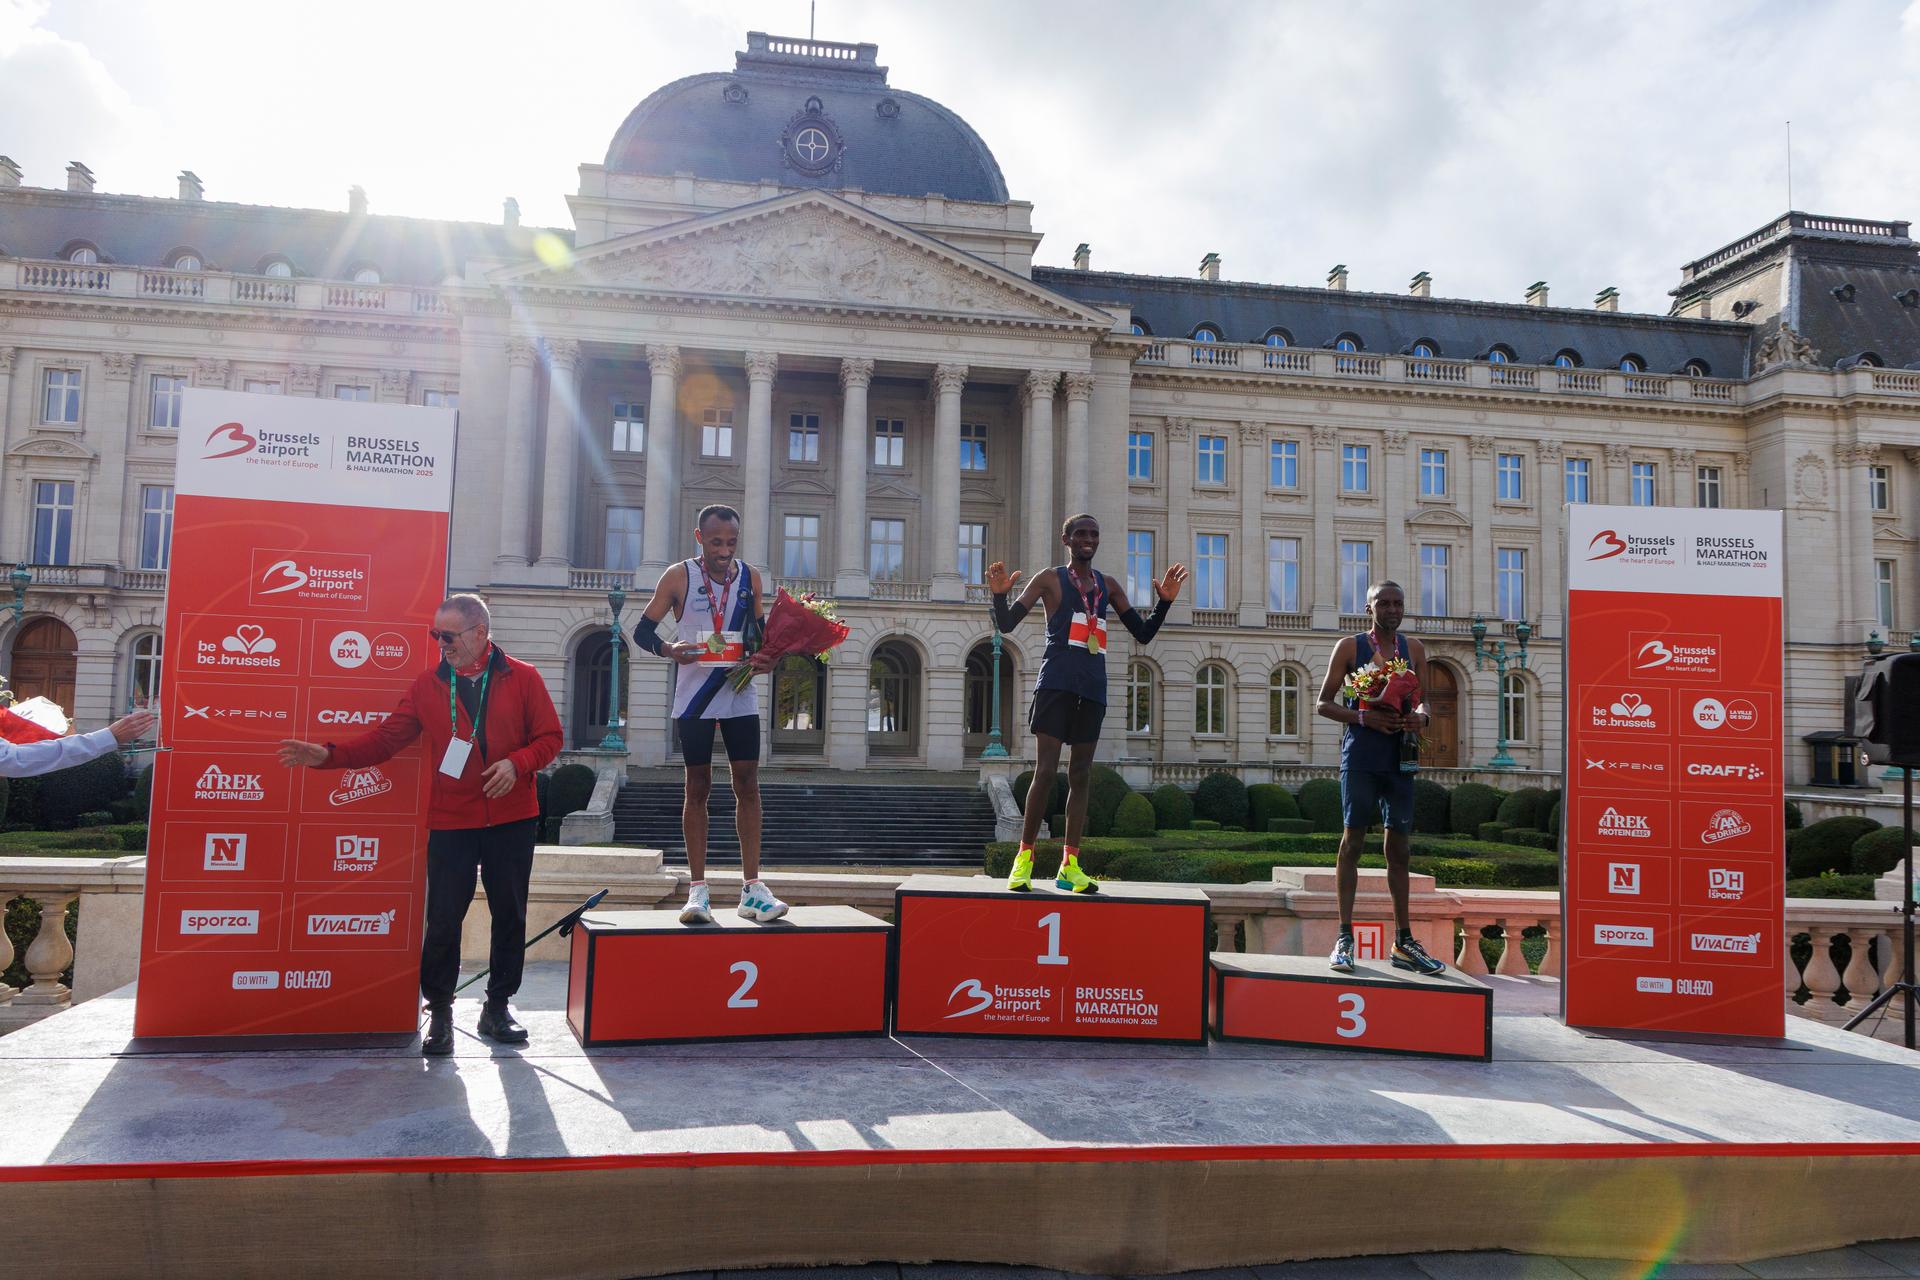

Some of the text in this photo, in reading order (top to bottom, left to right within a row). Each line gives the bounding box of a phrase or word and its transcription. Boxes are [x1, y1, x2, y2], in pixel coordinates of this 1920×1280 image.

[259, 430, 320, 445] brussels
[347, 436, 419, 452] BRUSSELS
[258, 443, 309, 457] airport
[261, 458, 281, 466] heart
[292, 460, 319, 469] Europe
[346, 450, 435, 467] MARATHON
[372, 467, 414, 475] MARATHON
[1628, 535, 1675, 546] brussels
[1696, 537, 1754, 548] BRUSSELS
[1628, 545, 1667, 556] airport
[1696, 549, 1767, 560] MARATHON
[310, 566, 363, 580] brussels
[309, 578, 354, 591] airport
[198, 640, 216, 652] be
[1673, 645, 1716, 656] brussels
[337, 648, 362, 659] BXL
[1673, 654, 1709, 666] airport
[214, 709, 287, 718] XPENG
[318, 710, 392, 724] CRAFT
[1593, 706, 1606, 716] be
[1700, 713, 1719, 722] BXL
[1609, 762, 1664, 771] XPENG
[1687, 764, 1747, 777] CRAFT
[202, 773, 264, 790] TREK
[353, 773, 376, 789] AA
[195, 791, 238, 800] PROTEIN
[242, 792, 262, 800] BARS
[349, 784, 381, 799] DRINK
[1604, 815, 1650, 829] TREK
[1720, 817, 1737, 830] AA
[1598, 828, 1631, 836] PROTEIN
[1717, 826, 1742, 840] DRINK
[211, 838, 240, 861] N
[339, 839, 374, 857] DH
[1614, 867, 1635, 886] N
[1712, 872, 1740, 888] DH
[188, 916, 251, 931] sporza.
[1037, 912, 1069, 965] 1
[1600, 930, 1648, 942] sporza.
[1358, 932, 1376, 959] H
[237, 975, 268, 985] GO WITH
[285, 970, 332, 989] GOLAZO
[726, 960, 759, 1009] 2
[1649, 981, 1664, 989] WITH
[995, 985, 1051, 998] brussels
[1075, 987, 1144, 1000] BRUSSELS
[1677, 979, 1713, 996] GOLAZO
[995, 998, 1040, 1012] airport
[1075, 1002, 1158, 1016] MARATHON
[996, 1013, 1016, 1021] heart
[1026, 1014, 1050, 1024] Europe
[1082, 1016, 1099, 1024] HALF
[1336, 993, 1367, 1038] 3
